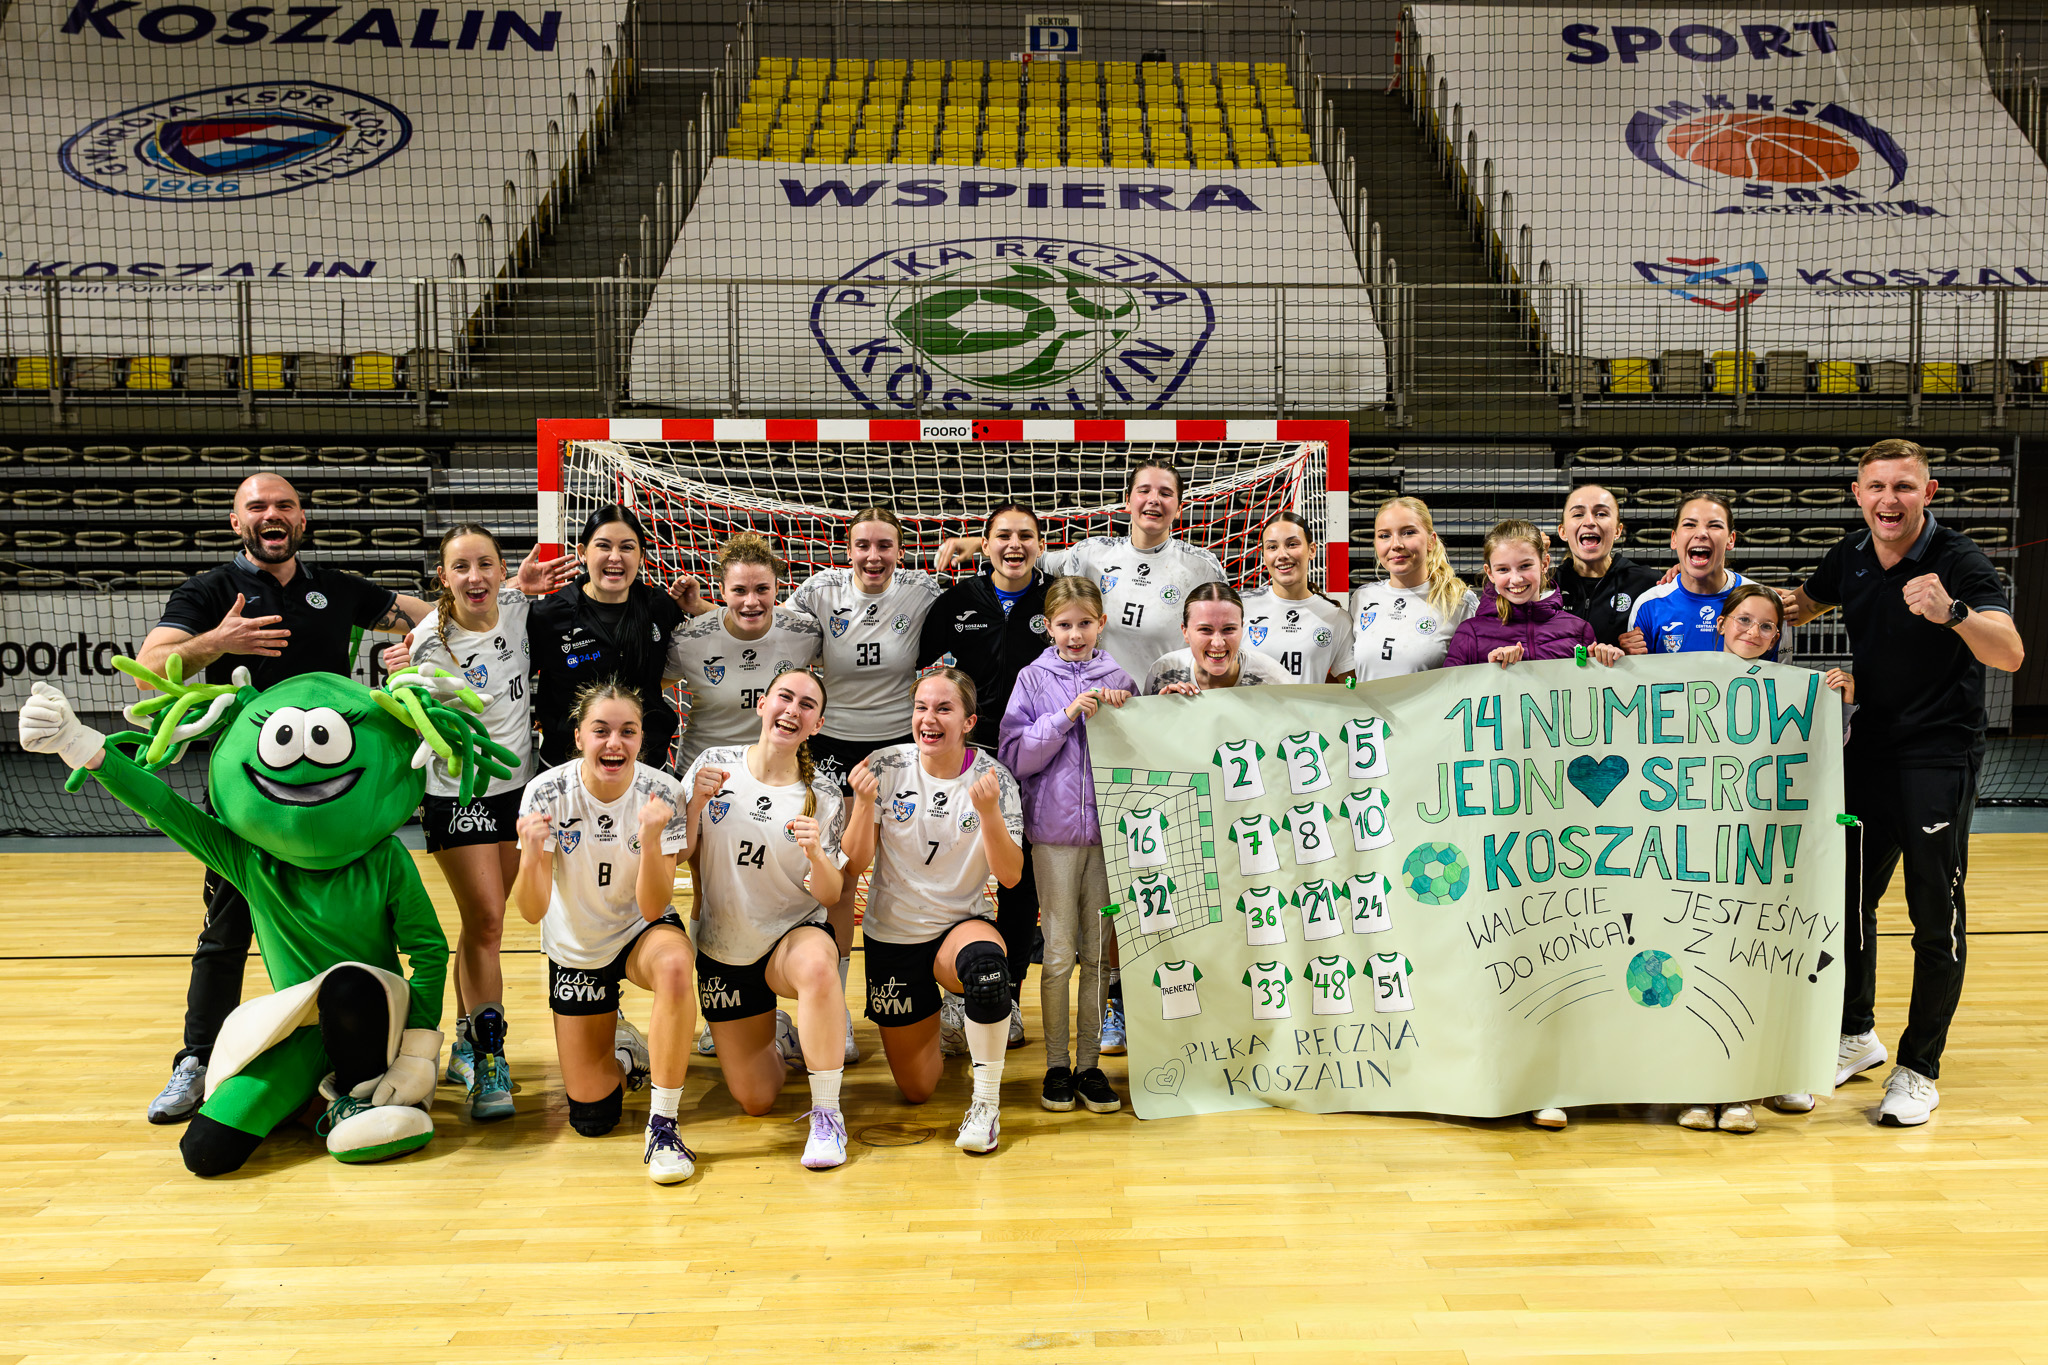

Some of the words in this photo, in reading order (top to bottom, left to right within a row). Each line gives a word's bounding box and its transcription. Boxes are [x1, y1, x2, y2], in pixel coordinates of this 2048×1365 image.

[61, 0, 563, 52] KOSZALIN
[1038, 17, 1070, 26] SEKTOR
[1039, 28, 1069, 50] D
[1562, 20, 1838, 65] SPORT
[1654, 93, 1817, 121] MKKS
[84, 105, 199, 175] GWARDIA
[225, 89, 335, 109] KSPR
[281, 107, 388, 182] KOSZALIN
[143, 178, 243, 194] 1966
[779, 178, 1262, 212] WSPIERA
[995, 243, 1188, 311] RĘCZNA
[923, 427, 967, 437] FOORO
[1122, 602, 1144, 627] 51
[857, 643, 880, 666] 33
[1280, 651, 1302, 675] 48
[1381, 637, 1395, 660] 5
[509, 674, 523, 702] 10
[1444, 694, 1504, 752] 14
[1520, 665, 1820, 749] NUMERÓW
[1355, 732, 1378, 770] 5
[1229, 756, 1253, 789] 2
[1293, 746, 1322, 786] 3
[1640, 752, 1810, 812] SERCE
[457, 816, 497, 832] GYM
[1299, 820, 1321, 850] 8
[1355, 800, 1385, 841] 10
[925, 841, 939, 865] 7
[1130, 823, 1156, 855] 16
[1243, 830, 1263, 856] 7
[737, 840, 766, 869] 24
[1483, 824, 1802, 892] KOSZALIN!
[598, 862, 612, 887] 8
[1140, 884, 1171, 918] 32
[1302, 886, 1332, 924] 21
[1355, 893, 1383, 921] 24
[1663, 888, 1839, 943] JESTEŚMY
[1248, 905, 1277, 929] 36
[1466, 887, 1611, 949] WALCZCIE
[1484, 956, 1533, 995] DO
[1539, 912, 1635, 966] KOŃCA!
[1684, 928, 1713, 955] Z
[1729, 937, 1835, 984] WAMI!
[554, 965, 598, 998] just
[699, 975, 727, 992] ust
[869, 976, 907, 1001] just
[979, 971, 1001, 983] SELECT
[1161, 983, 1195, 996] TRENERZY
[1314, 970, 1346, 1001] 48
[1378, 970, 1404, 999] 51
[559, 984, 606, 1002] GYM
[702, 990, 741, 1009] GYM
[872, 997, 912, 1015] GYM
[1257, 978, 1286, 1009] 33
[1180, 1034, 1270, 1064] PIŁKA
[1294, 1019, 1420, 1057] RĘCZNA
[1223, 1059, 1392, 1096] KOSZALIN
